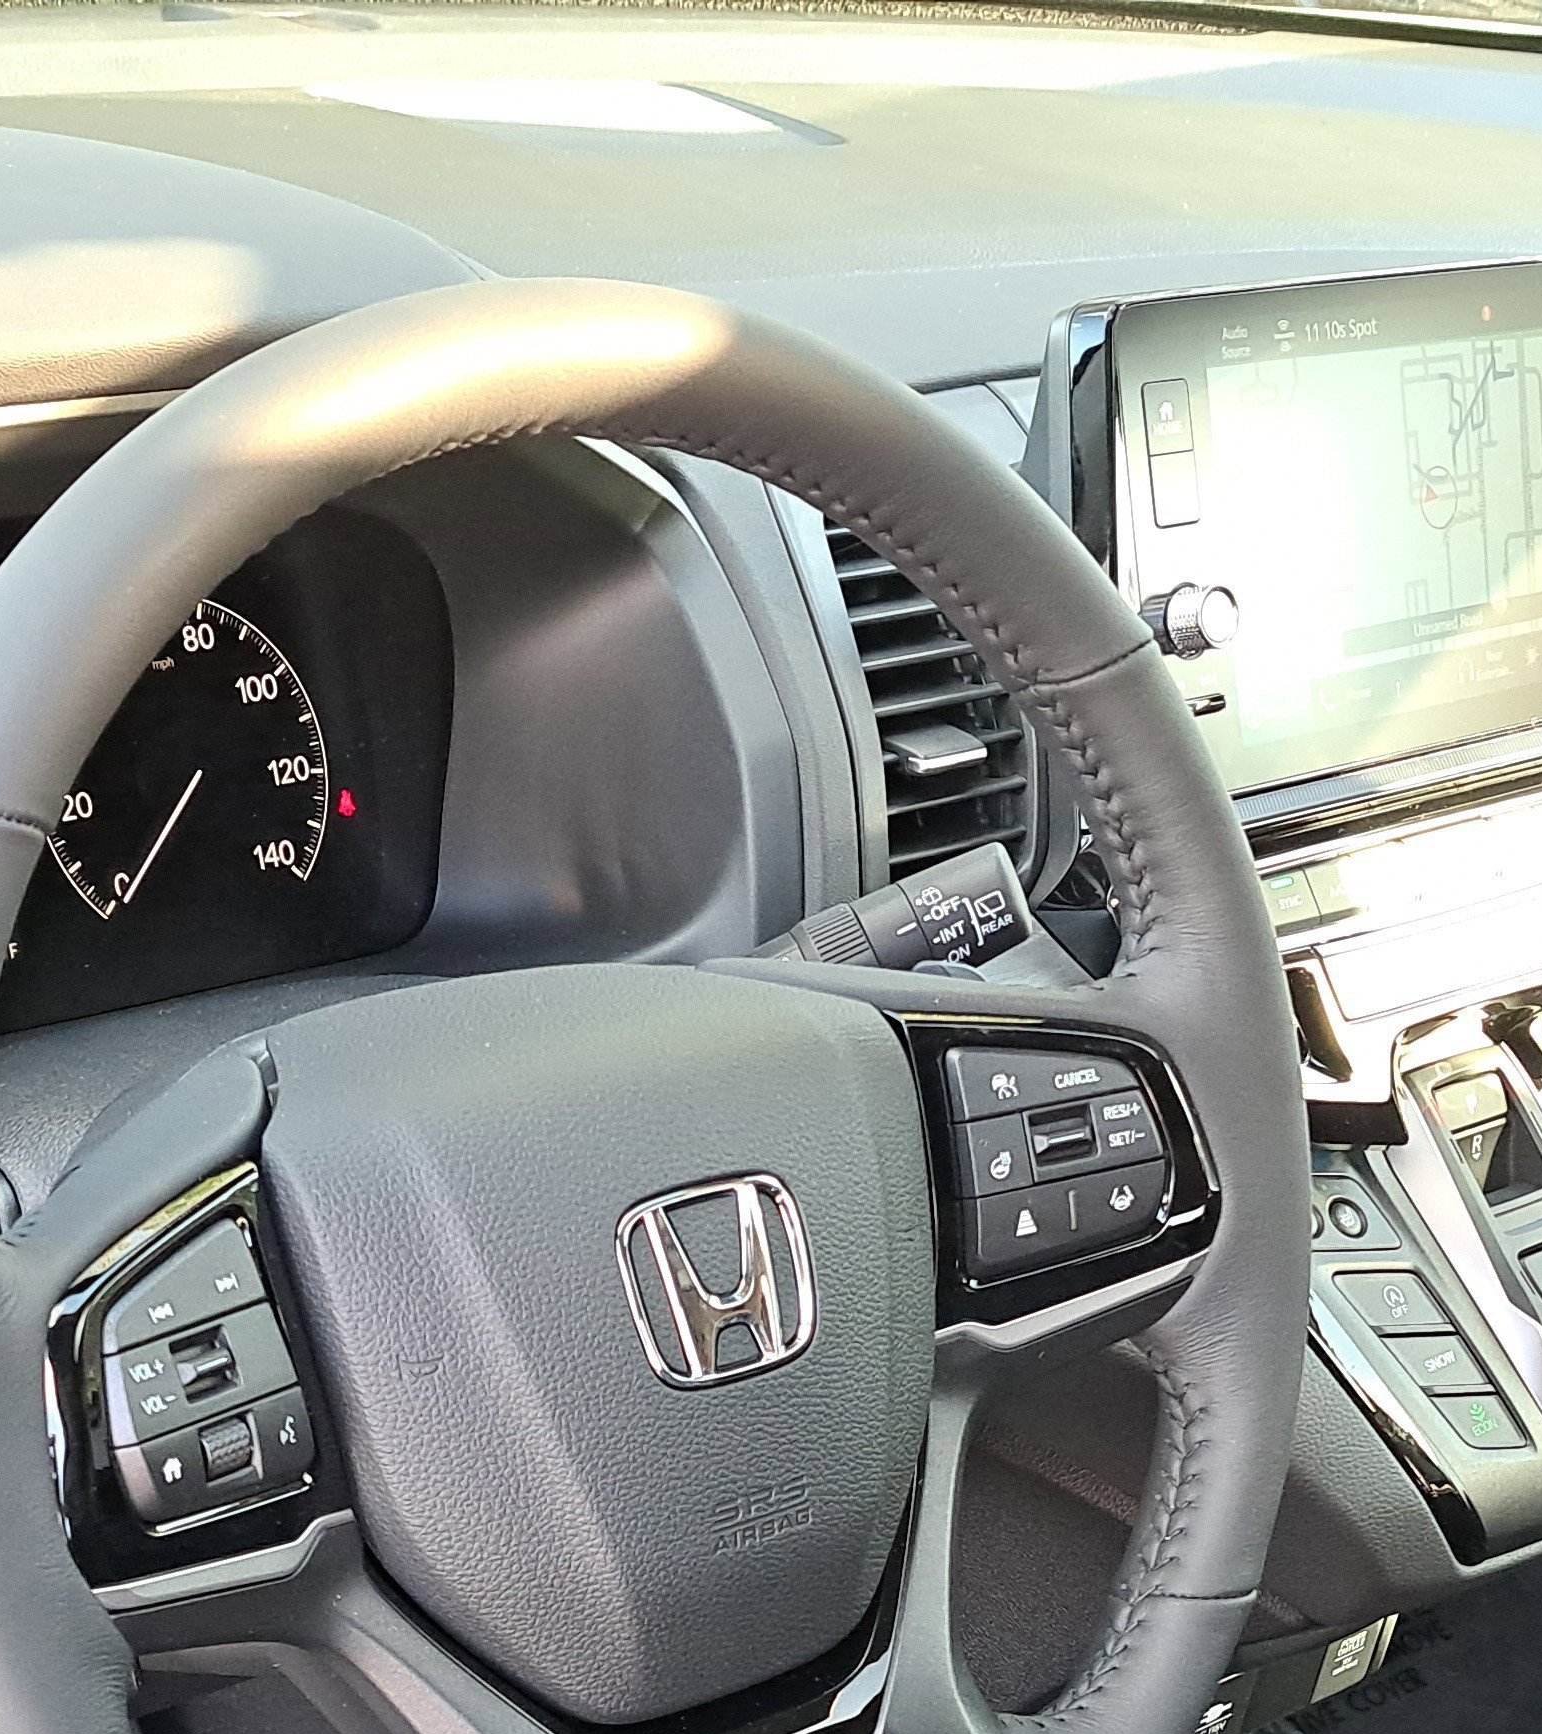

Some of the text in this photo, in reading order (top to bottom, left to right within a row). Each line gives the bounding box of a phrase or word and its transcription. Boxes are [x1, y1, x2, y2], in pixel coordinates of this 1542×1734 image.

[1221, 325, 1249, 341] Audio
[1348, 317, 1378, 338] Spot
[1221, 346, 1251, 359] Source
[1413, 612, 1484, 637] Unnamed Road
[182, 623, 215, 652] 80
[152, 656, 174, 671] mph
[235, 673, 278, 704] 100
[267, 756, 310, 786] 120
[61, 791, 93, 822] 20
[253, 839, 295, 870] 140
[931, 896, 961, 920] OFF
[939, 920, 965, 944] INT
[981, 914, 1014, 935] REAR
[8, 943, 19, 960] F
[948, 943, 971, 963] ON
[1055, 1067, 1101, 1089] CANCEL
[1470, 1134, 1484, 1153] R
[1391, 1304, 1408, 1319] OFF
[1423, 1350, 1456, 1373] SNOW
[1471, 1419, 1498, 1437] ECON
[712, 1474, 808, 1527] SRS
[715, 1508, 813, 1552] AIRBAG
